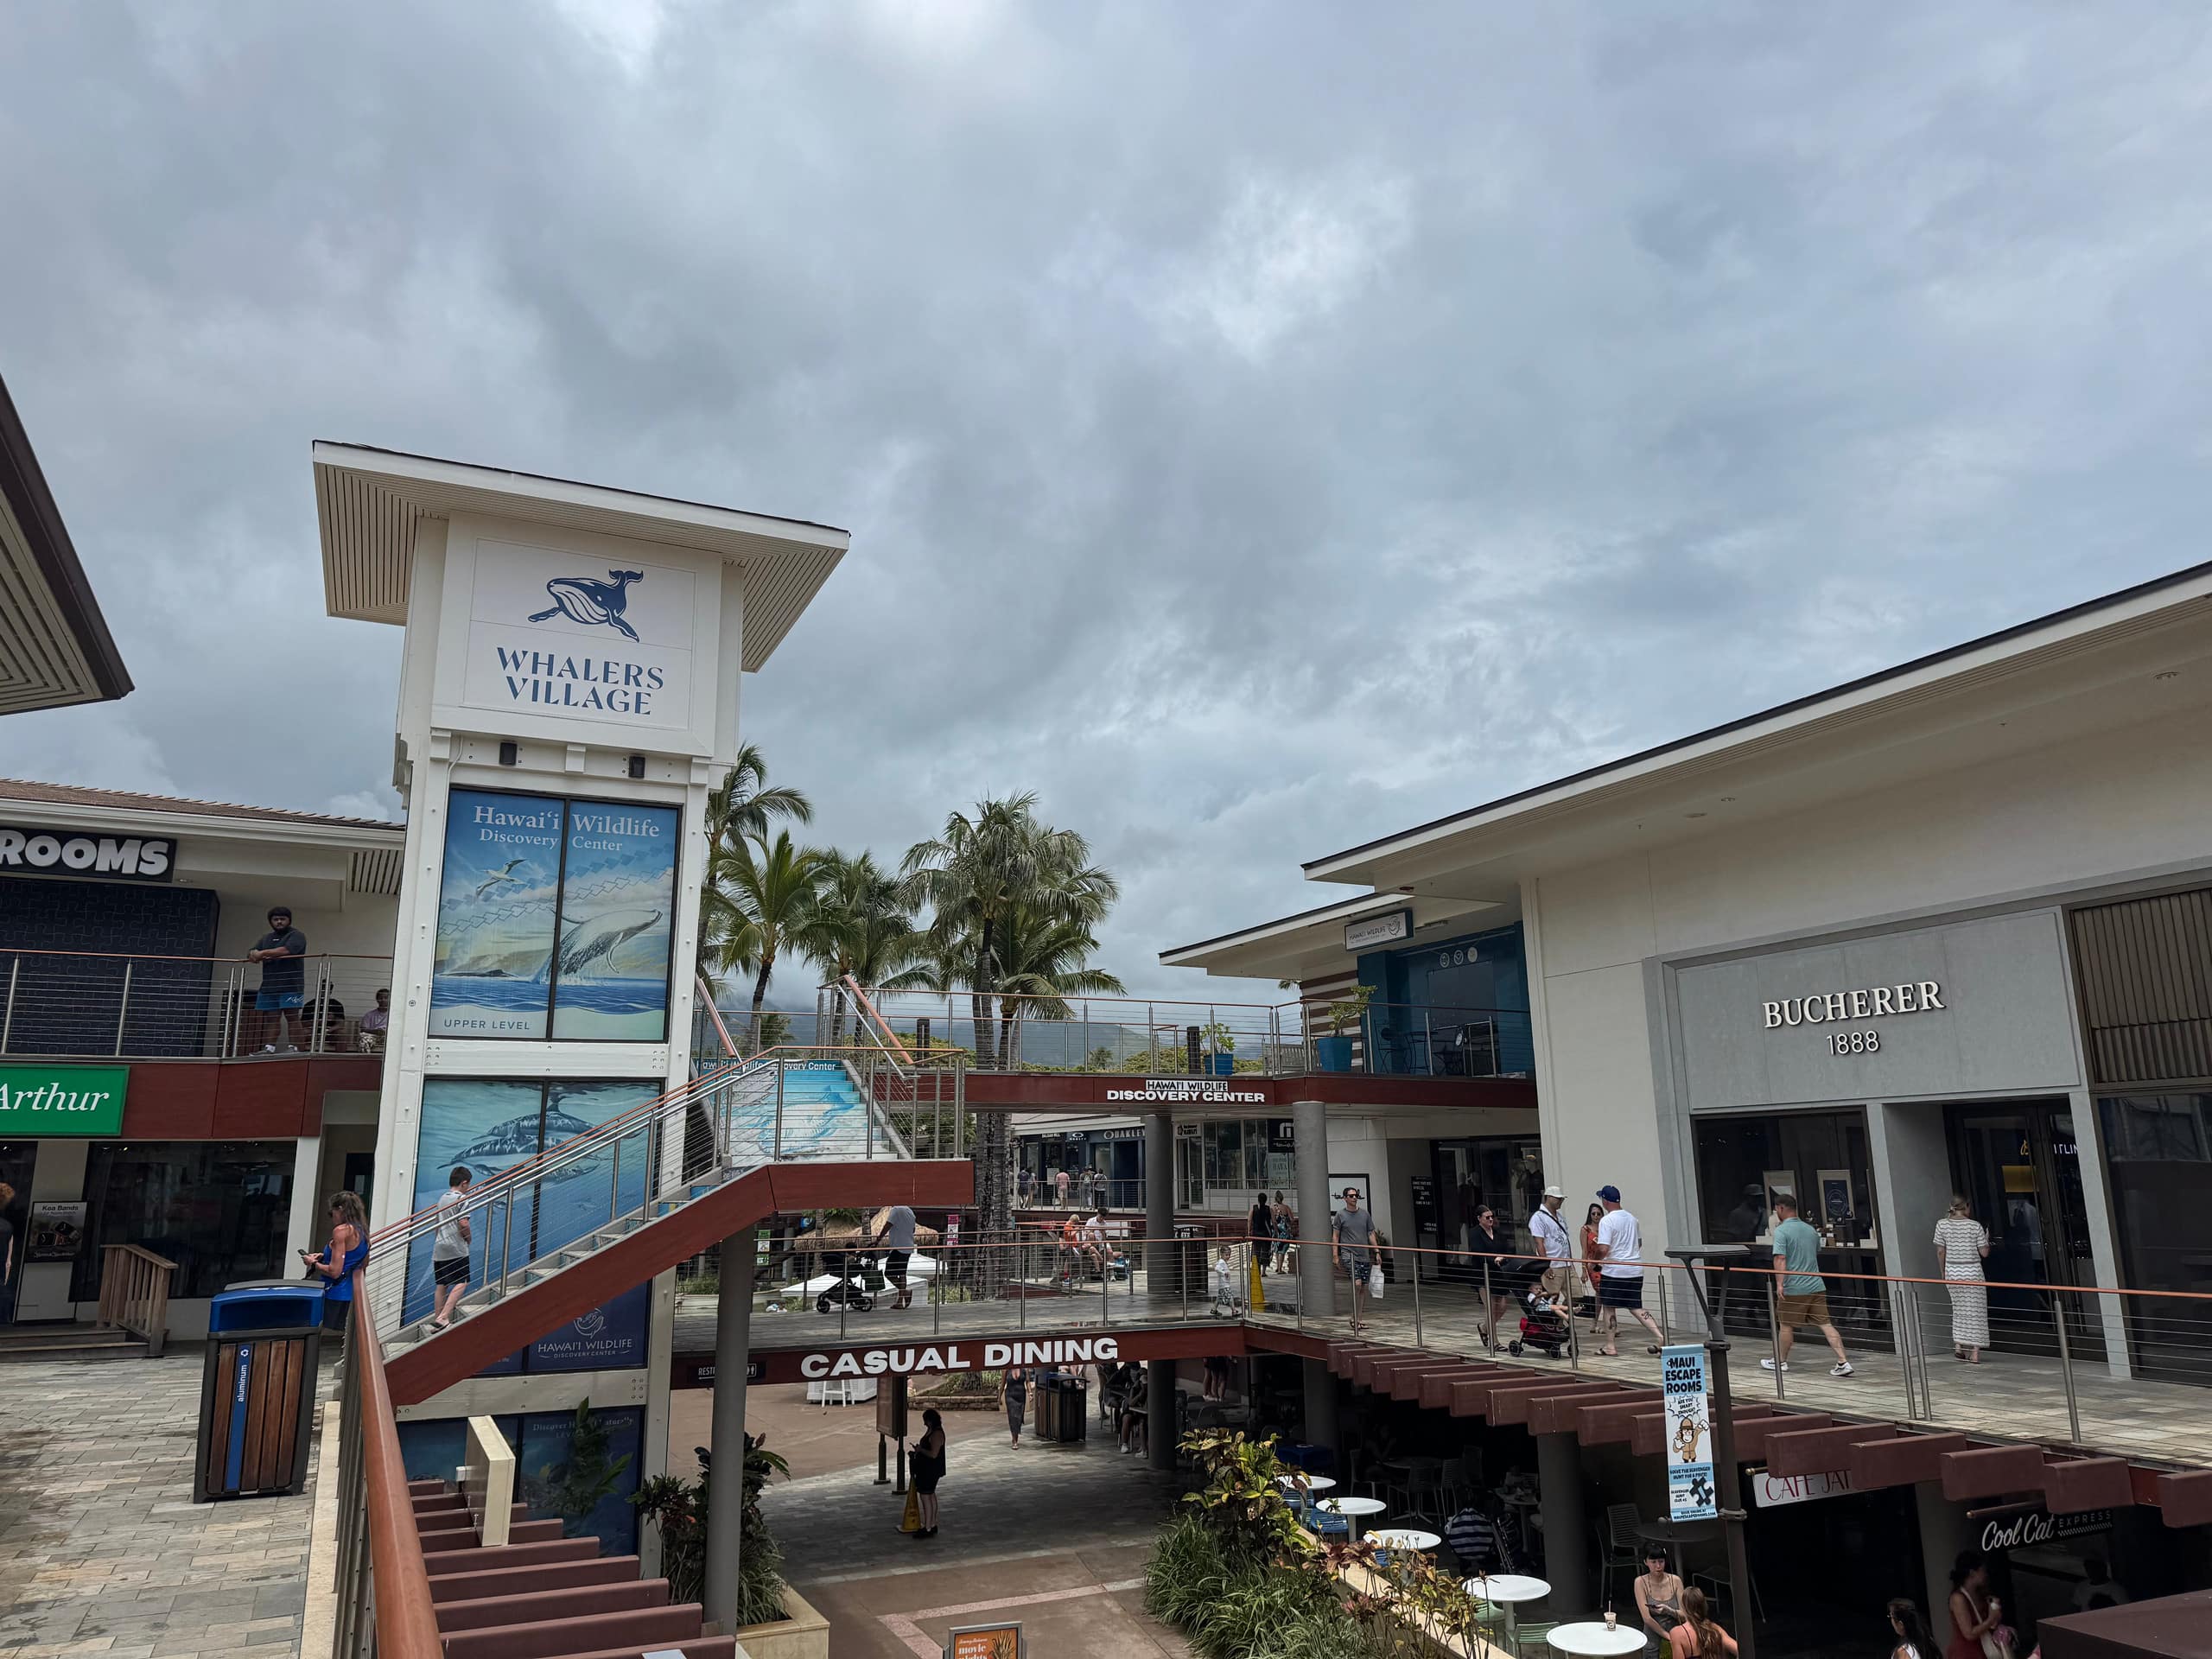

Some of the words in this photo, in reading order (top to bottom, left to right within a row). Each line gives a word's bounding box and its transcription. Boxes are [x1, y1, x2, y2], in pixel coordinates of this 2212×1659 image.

[497, 647, 664, 690] WHALERS
[506, 676, 652, 715] VILLAGE
[572, 814, 660, 836] Wildlife
[480, 828, 560, 849] Discovery
[572, 836, 622, 850] Center
[0, 830, 169, 875] ROOMS
[1367, 926, 1386, 936] WILDLIFE
[1763, 982, 1946, 1029] BUCHERER
[444, 1020, 486, 1028] UPPER
[493, 1021, 531, 1030] LEVEL
[1827, 1030, 1881, 1056] 1888
[1147, 1082, 1184, 1090] HAWAI'I
[1187, 1082, 1227, 1091] WILDLIFE
[1107, 1090, 1201, 1101] DISCOVERY
[1203, 1091, 1265, 1103] CENTER
[537, 1341, 581, 1353] HAWAI'I
[586, 1339, 632, 1350] WILDLIFE
[801, 1345, 971, 1377] CASUAL
[983, 1338, 1118, 1367] DINING
[1669, 1357, 1695, 1369] MAUI
[698, 1367, 715, 1376] REST
[1666, 1369, 1701, 1382] ESCAPE
[237, 1364, 247, 1402] aluminum
[1666, 1381, 1702, 1394] ROOMS
[1981, 1517, 2024, 1552] Cool
[2024, 1513, 2056, 1543] Cat
[2058, 1511, 2112, 1528] EXPRESS
[959, 1643, 987, 1654] movie
